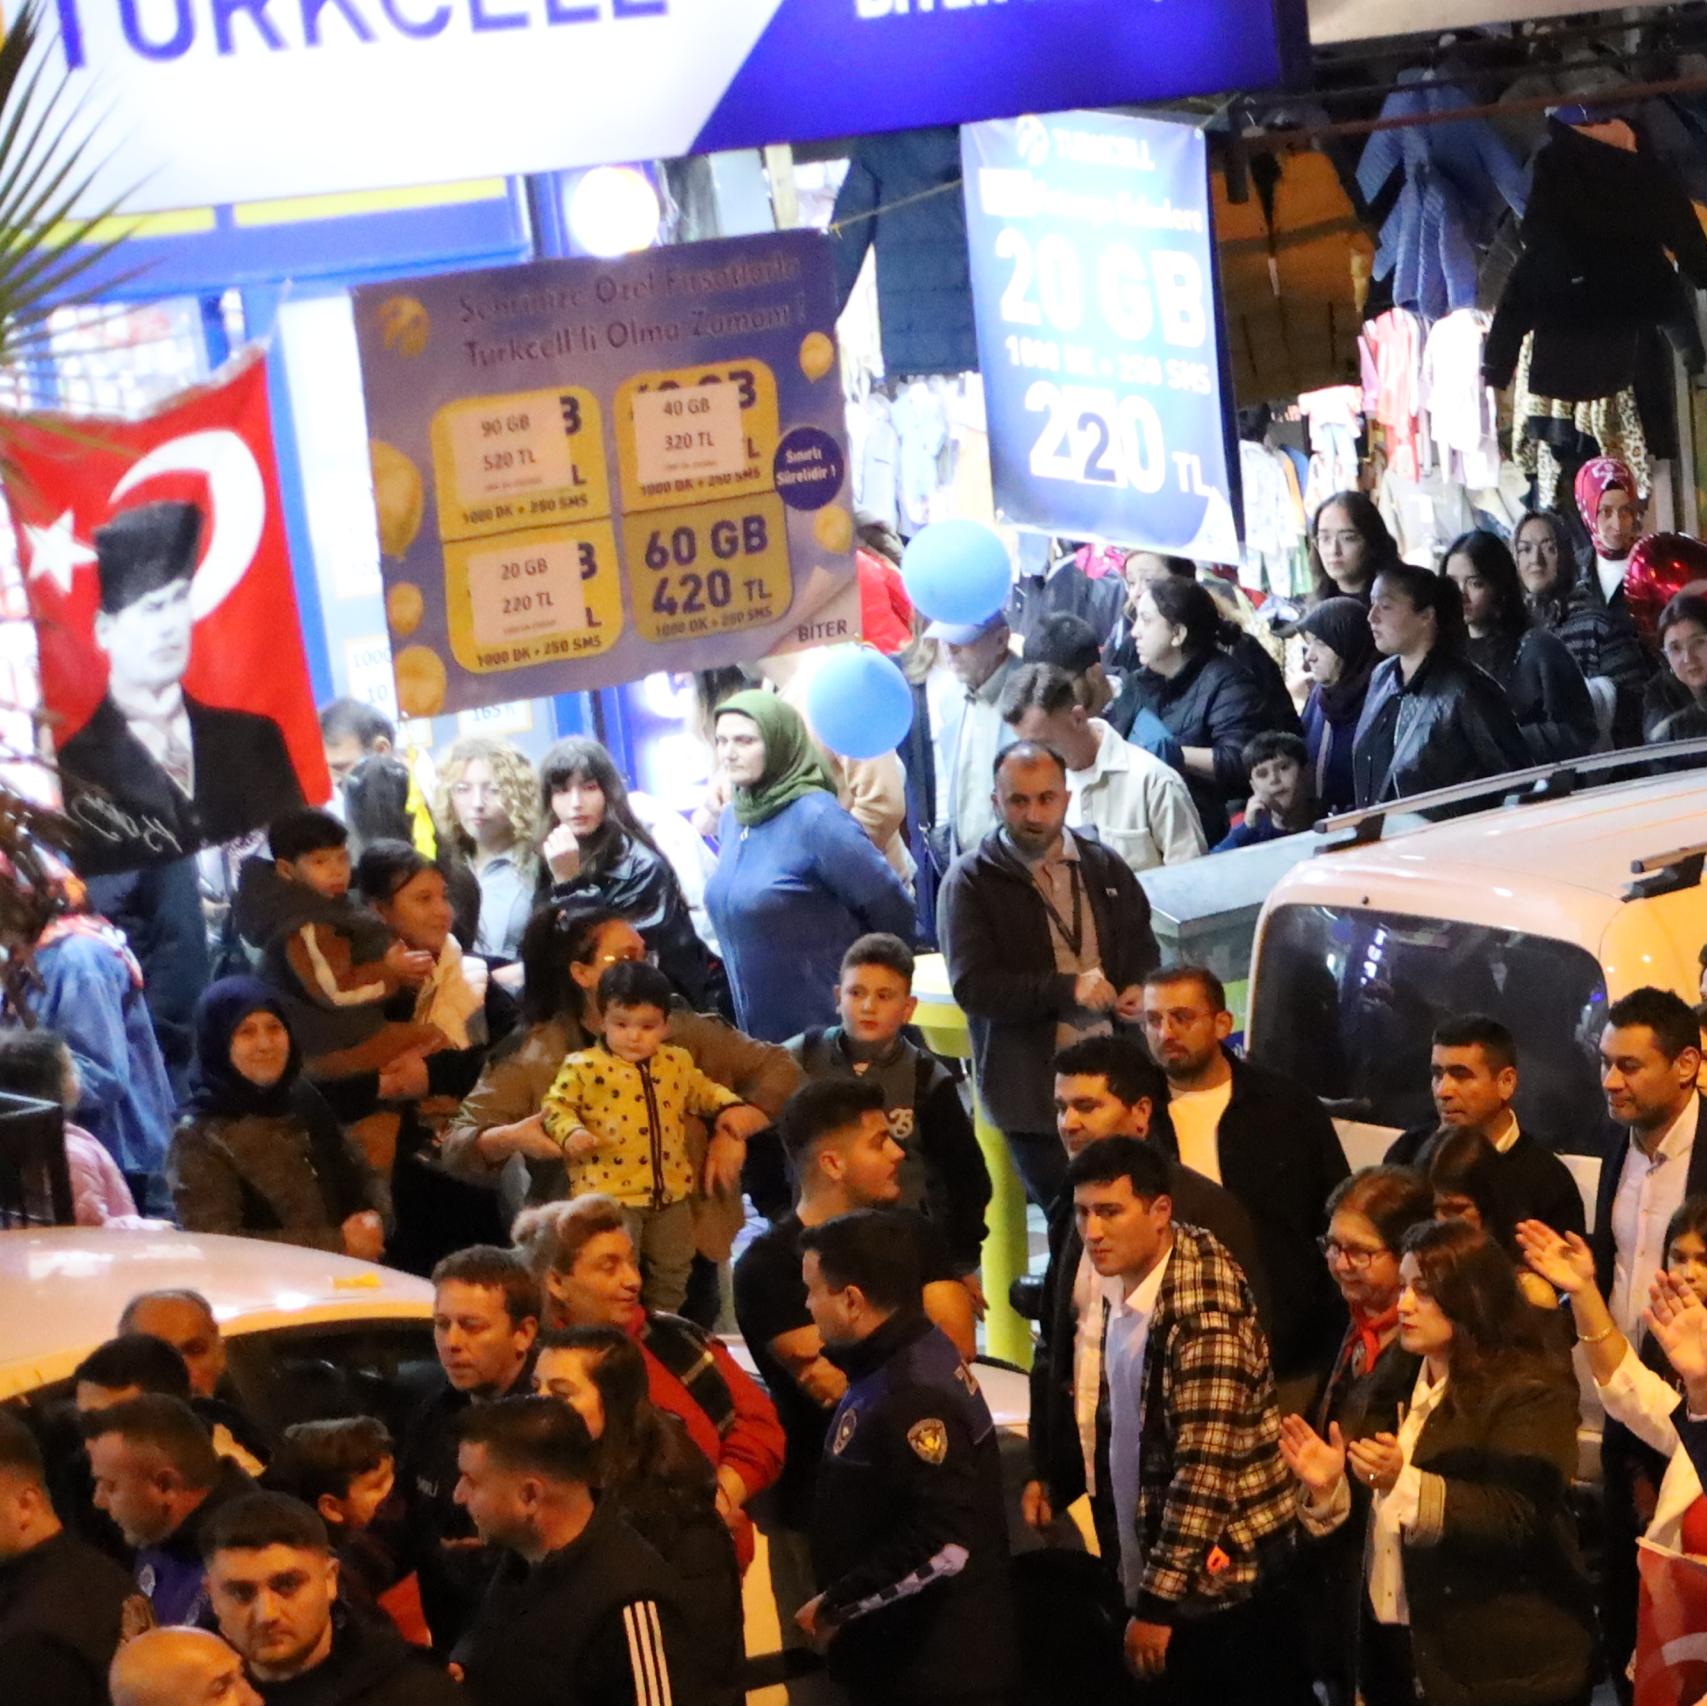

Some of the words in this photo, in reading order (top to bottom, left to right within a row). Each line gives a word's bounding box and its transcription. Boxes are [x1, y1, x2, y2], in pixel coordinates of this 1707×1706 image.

[995, 226, 1083, 331] 20
[1098, 242, 1207, 348] GB
[606, 319, 681, 348] Olma
[664, 400, 683, 416] 40
[687, 397, 711, 414] GB
[506, 414, 530, 433] GB
[664, 432, 693, 451] 320
[697, 431, 715, 447] TL
[483, 451, 513, 472] 520
[517, 449, 537, 465] TL
[1172, 451, 1211, 498] TL
[645, 525, 697, 571] 60
[710, 514, 768, 560] GB
[501, 562, 520, 580] 20
[525, 557, 549, 576] GB
[536, 592, 554, 607] TL
[652, 569, 733, 617] 420
[743, 578, 773, 602] TL
[573, 634, 602, 651] SMS
